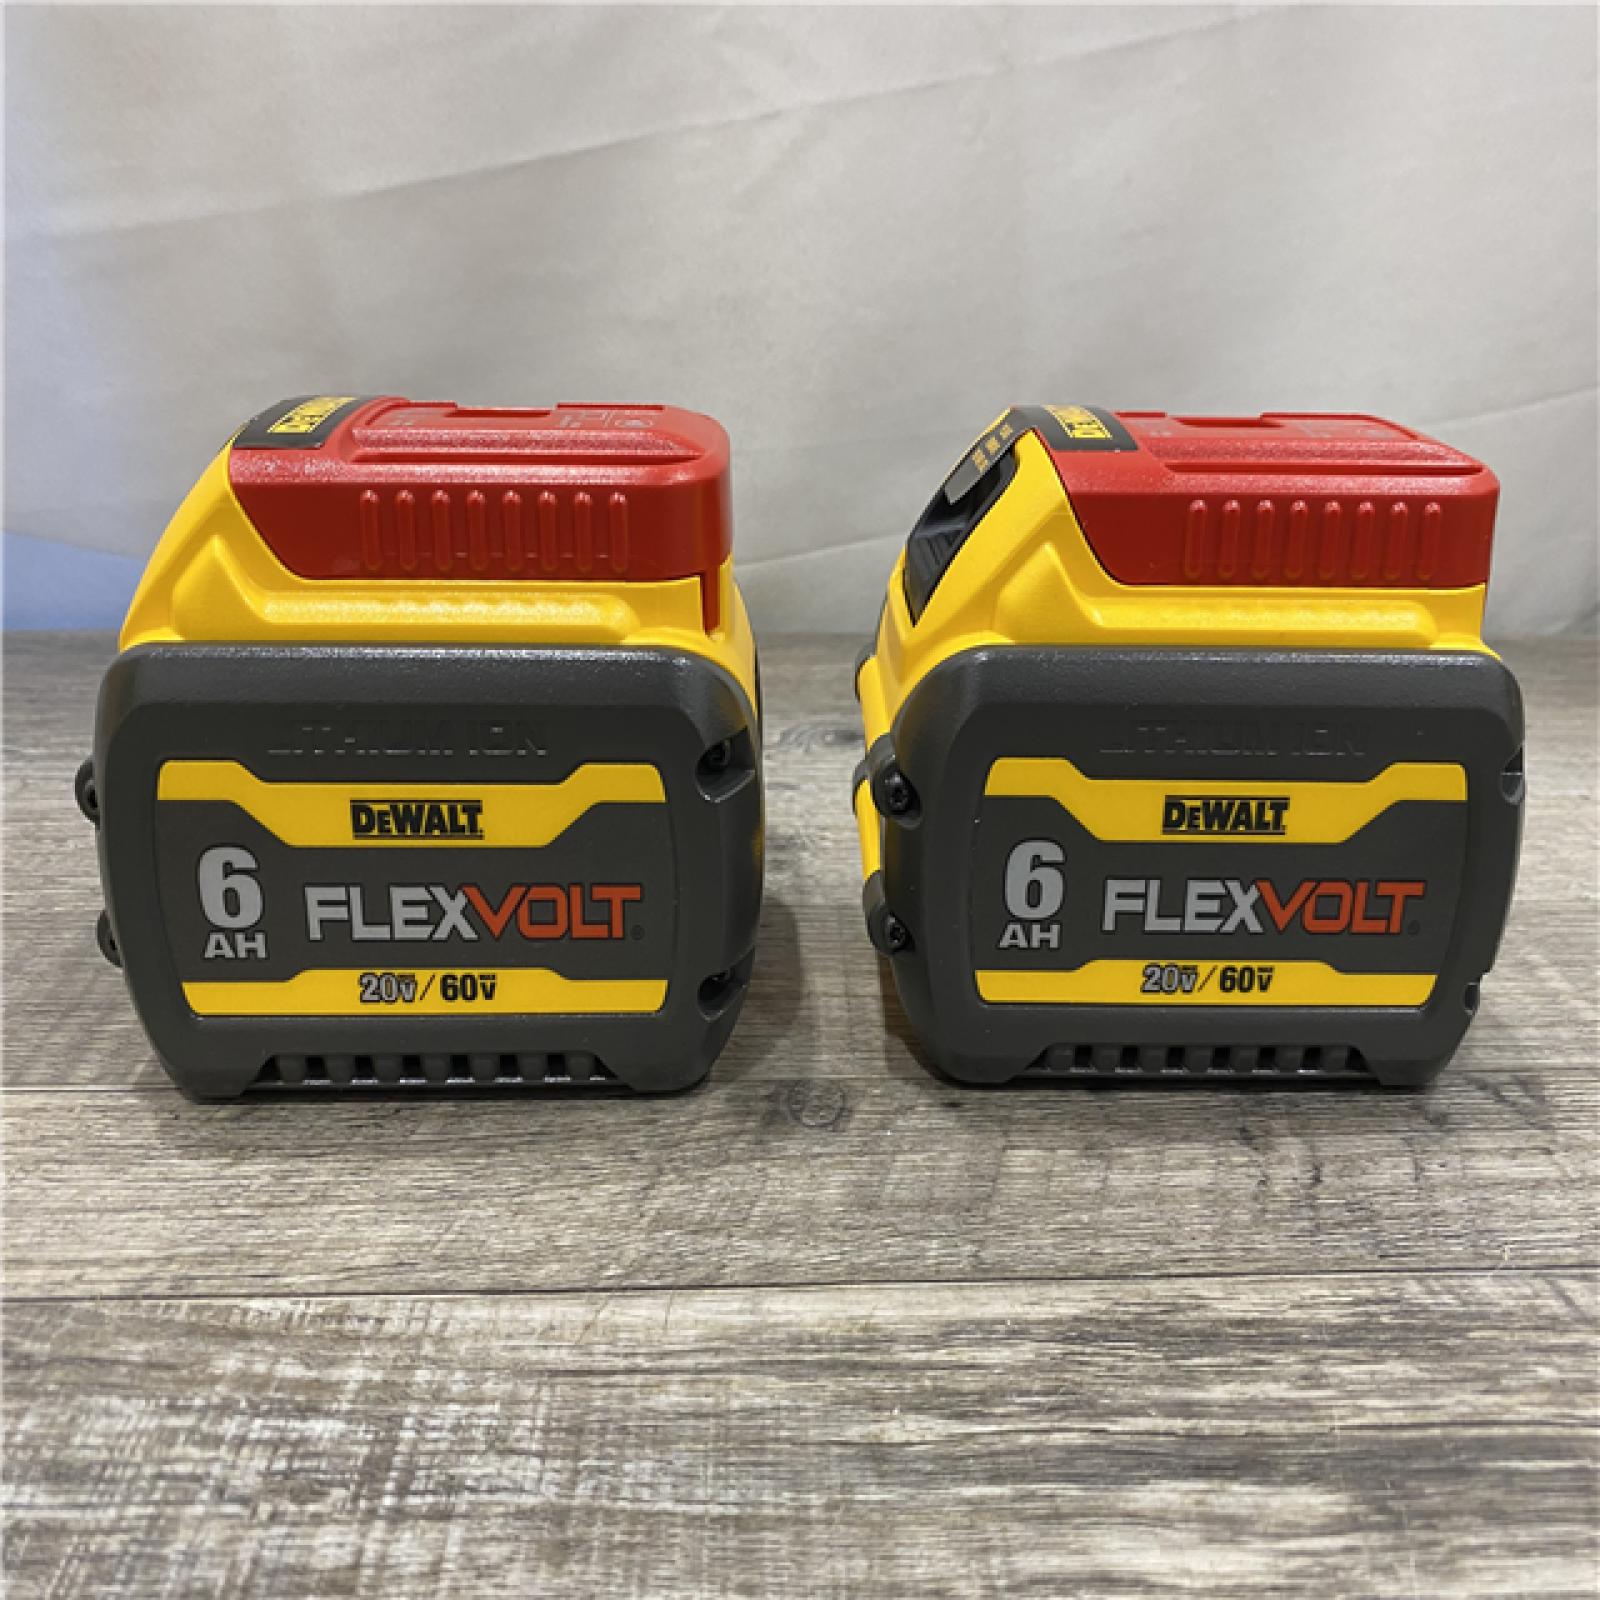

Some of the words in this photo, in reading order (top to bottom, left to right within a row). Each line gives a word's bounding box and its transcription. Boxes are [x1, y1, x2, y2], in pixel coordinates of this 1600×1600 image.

[199, 846, 264, 928] 6
[1005, 839, 1066, 920] 6
[1101, 879, 1426, 934] FLEXVOLT
[303, 885, 642, 941] FLEXVOLT
[998, 924, 1060, 948] AH
[204, 932, 267, 959] AH
